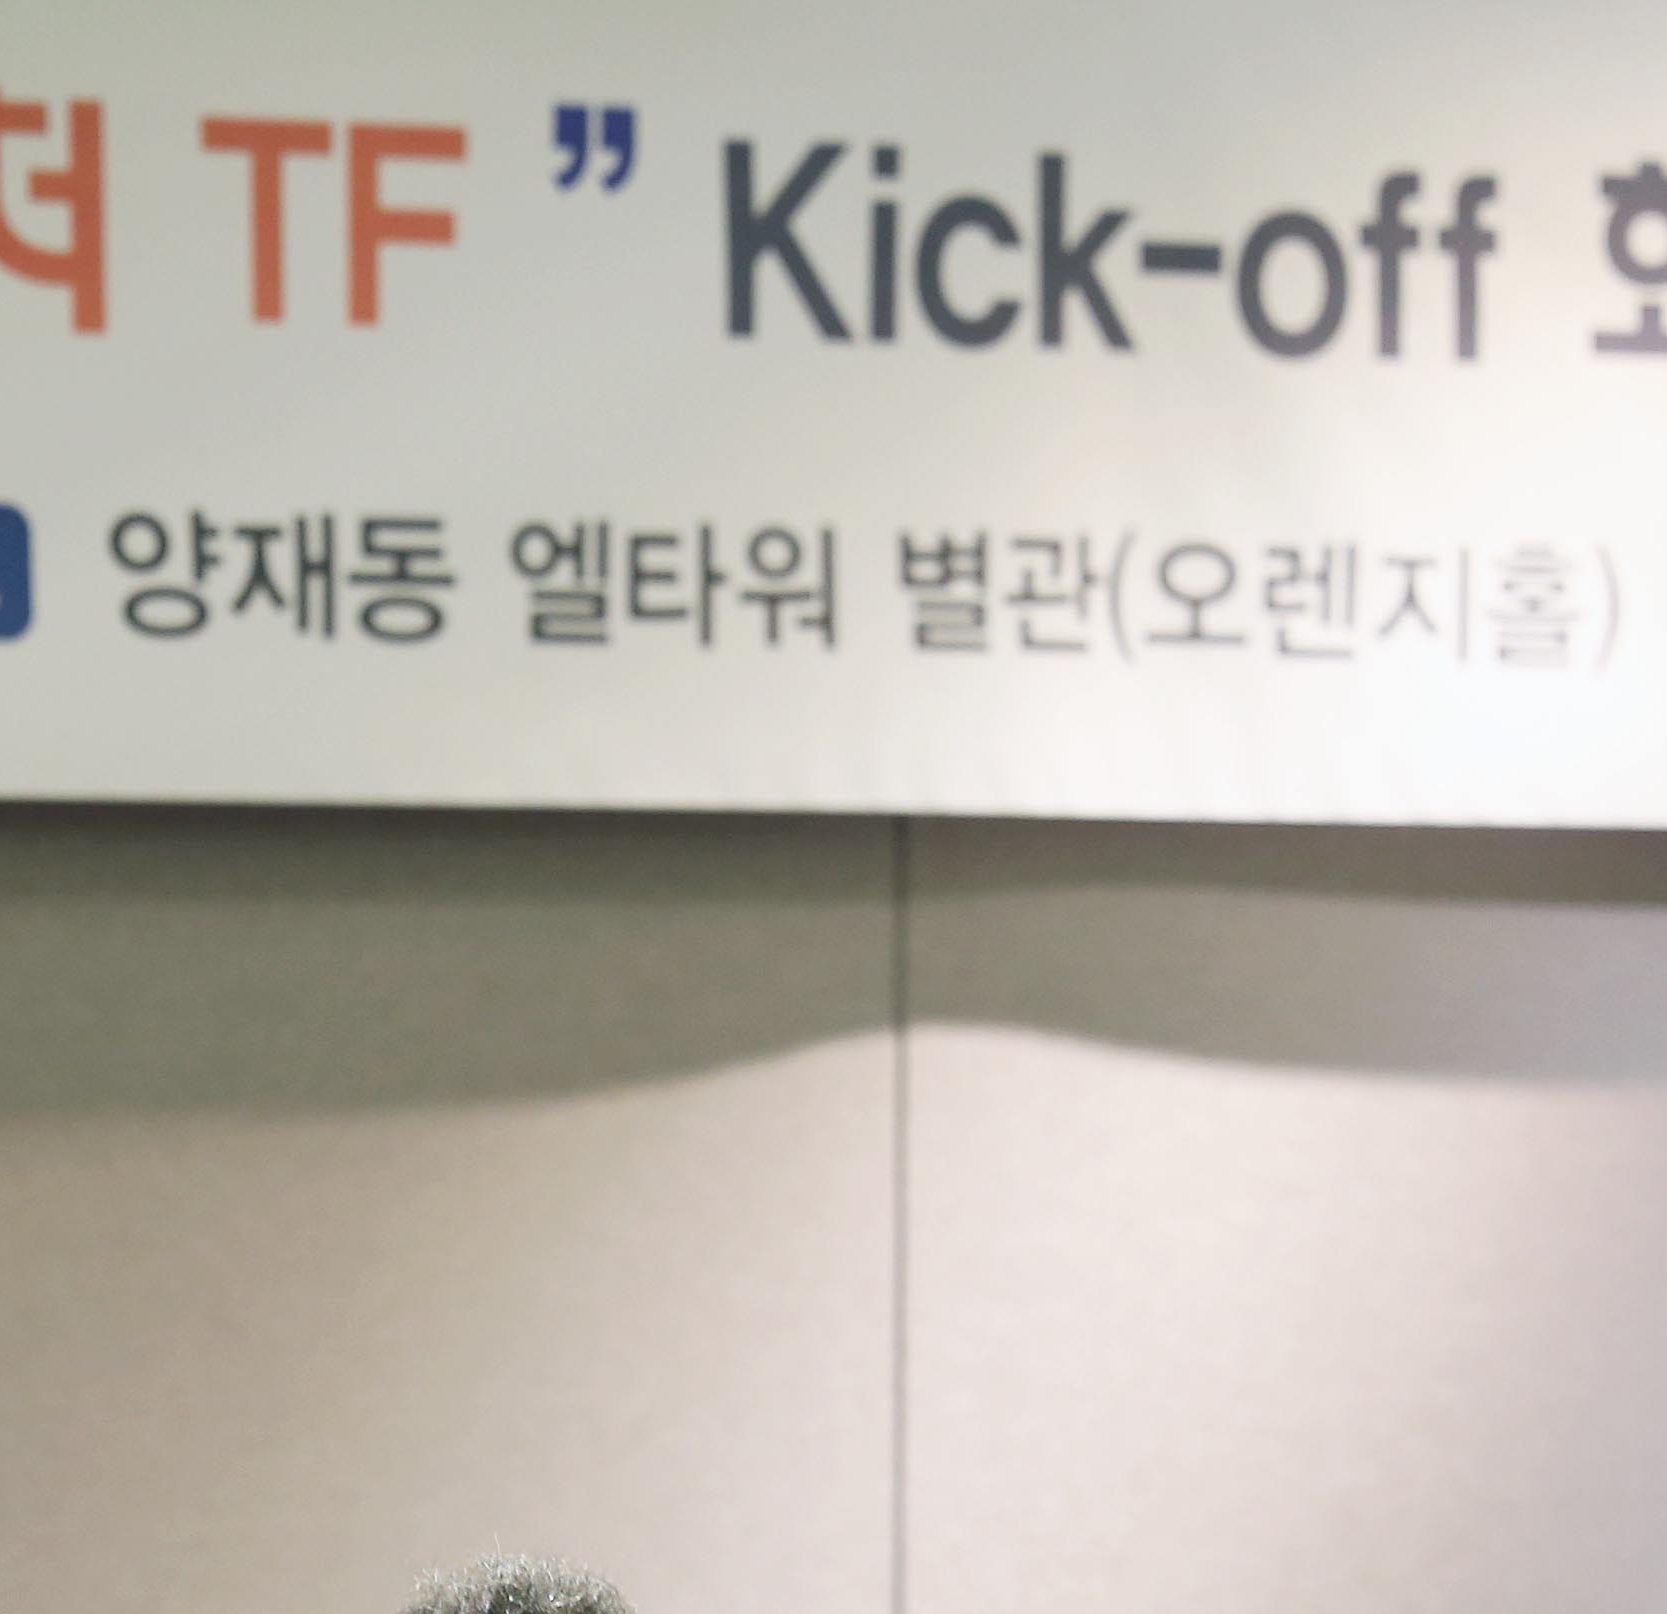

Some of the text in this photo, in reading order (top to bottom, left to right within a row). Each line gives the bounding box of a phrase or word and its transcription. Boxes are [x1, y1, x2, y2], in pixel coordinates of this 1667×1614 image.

[198, 113, 470, 328] TF
[721, 138, 1500, 364] Kick-off
[107, 510, 1621, 674] 양재동 엘타워 별관(오렌지홀)
